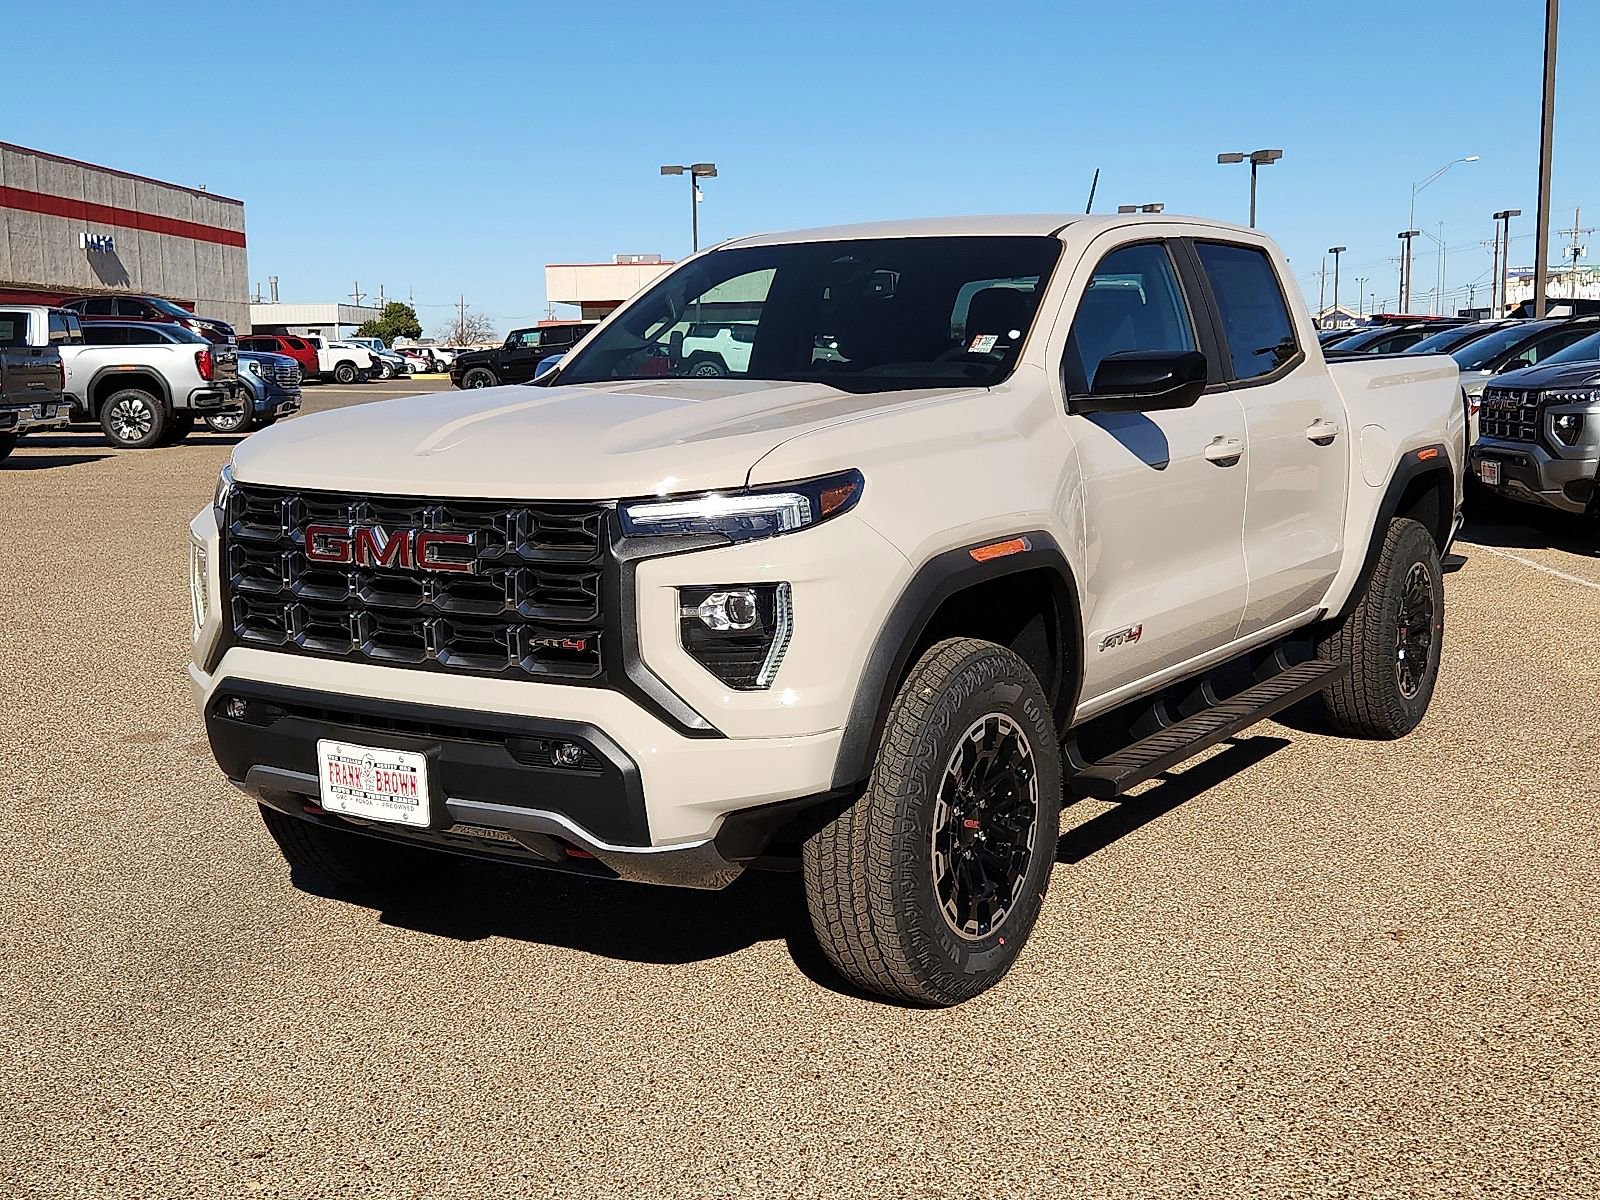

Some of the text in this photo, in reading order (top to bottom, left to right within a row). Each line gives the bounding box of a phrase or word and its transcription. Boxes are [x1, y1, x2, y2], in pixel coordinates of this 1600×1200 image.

[305, 524, 478, 574] GMC
[529, 638, 585, 652] AT4
[1099, 623, 1143, 653] AT4
[328, 761, 418, 797] FRANK BROWN
[355, 798, 374, 806] HONDA
[381, 802, 415, 812] PREOWNED
